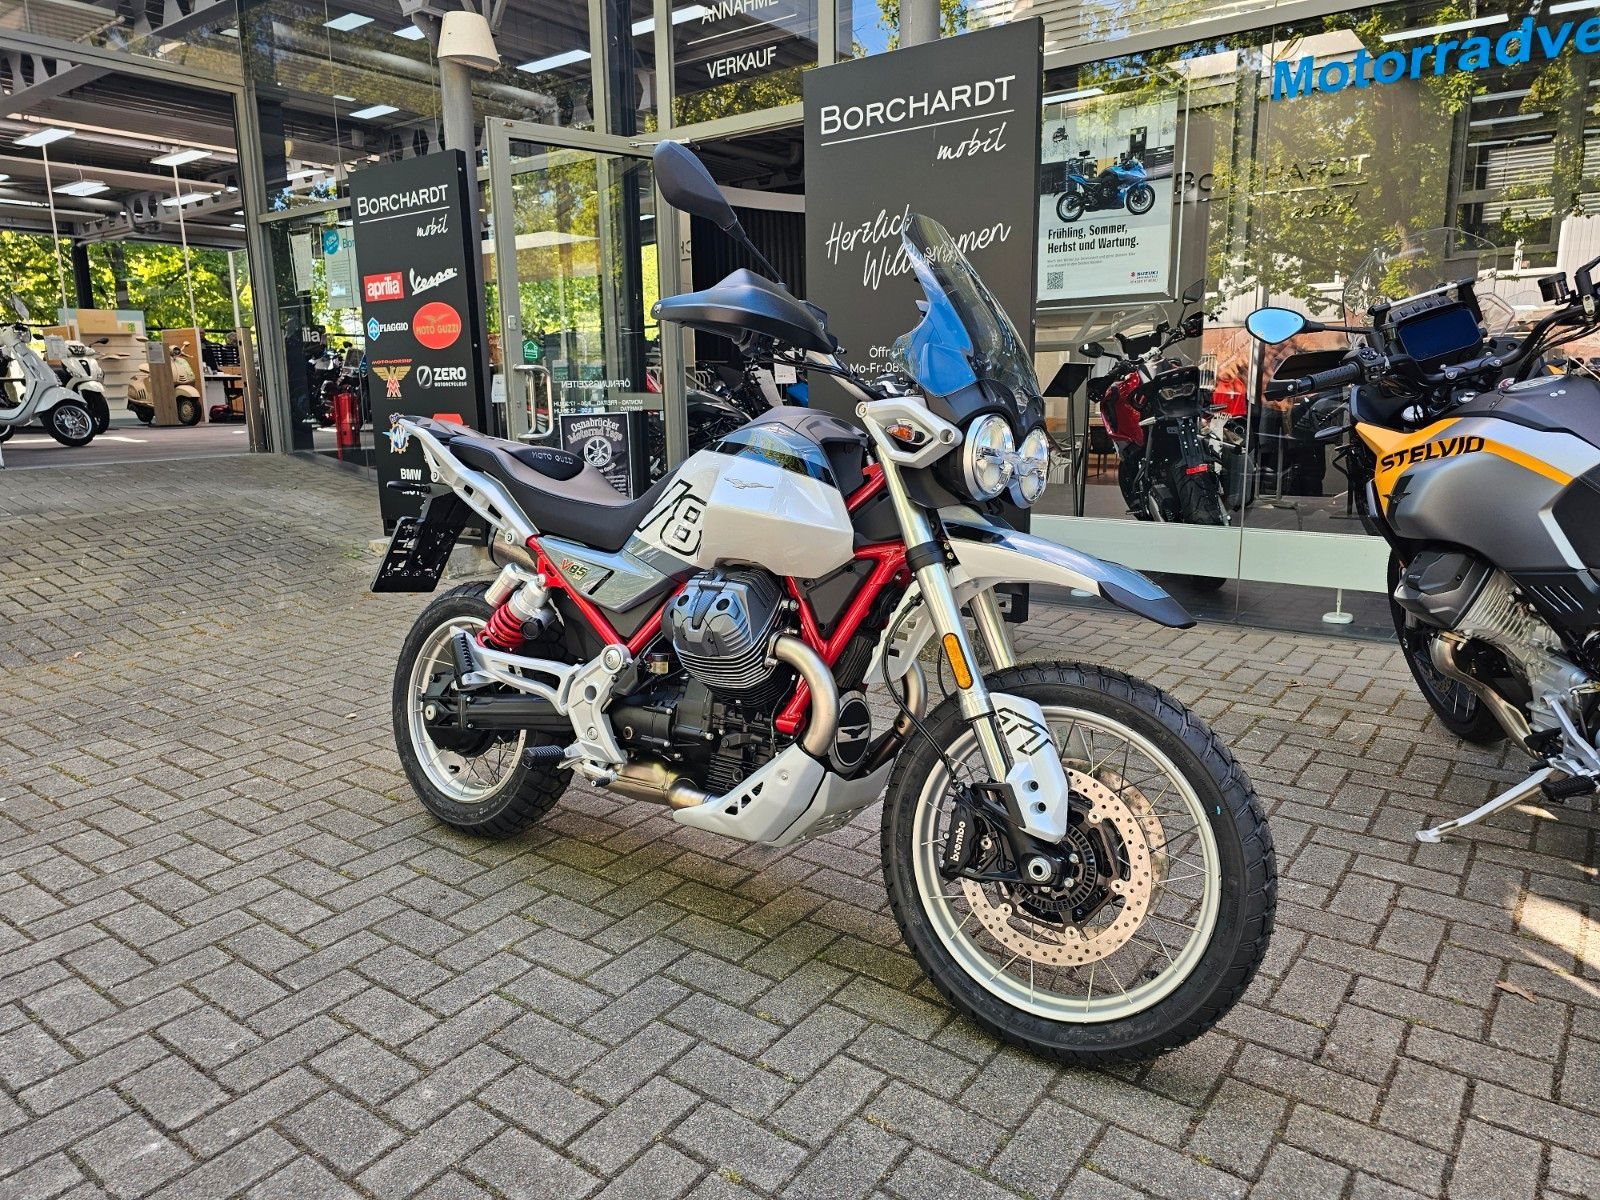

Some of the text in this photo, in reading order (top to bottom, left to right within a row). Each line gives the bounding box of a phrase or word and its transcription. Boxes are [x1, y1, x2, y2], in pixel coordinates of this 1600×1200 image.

[701, 0, 778, 25] ANNAHM
[706, 45, 777, 80] VERKAUF
[820, 74, 1016, 135] BORCHARDT
[936, 120, 1008, 160] mobil
[357, 184, 449, 217] BORCHARDT
[416, 214, 449, 238] mobil
[1048, 223, 1128, 240] Frühling, Sommer,
[1047, 236, 1139, 254] Herbst und Wartung.
[367, 276, 400, 300] aprilia
[409, 267, 458, 296] Vespa
[379, 322, 409, 333] PIAGGIO
[415, 323, 459, 335] MOTO GUZZI
[433, 366, 467, 381] ZERO
[566, 427, 623, 444] Motorrad Tage
[570, 417, 620, 432] Osnabrücker
[1380, 435, 1486, 473] STELVIO
[400, 468, 422, 481] BMW
[561, 559, 589, 576] V85
[949, 820, 966, 863] brembo
